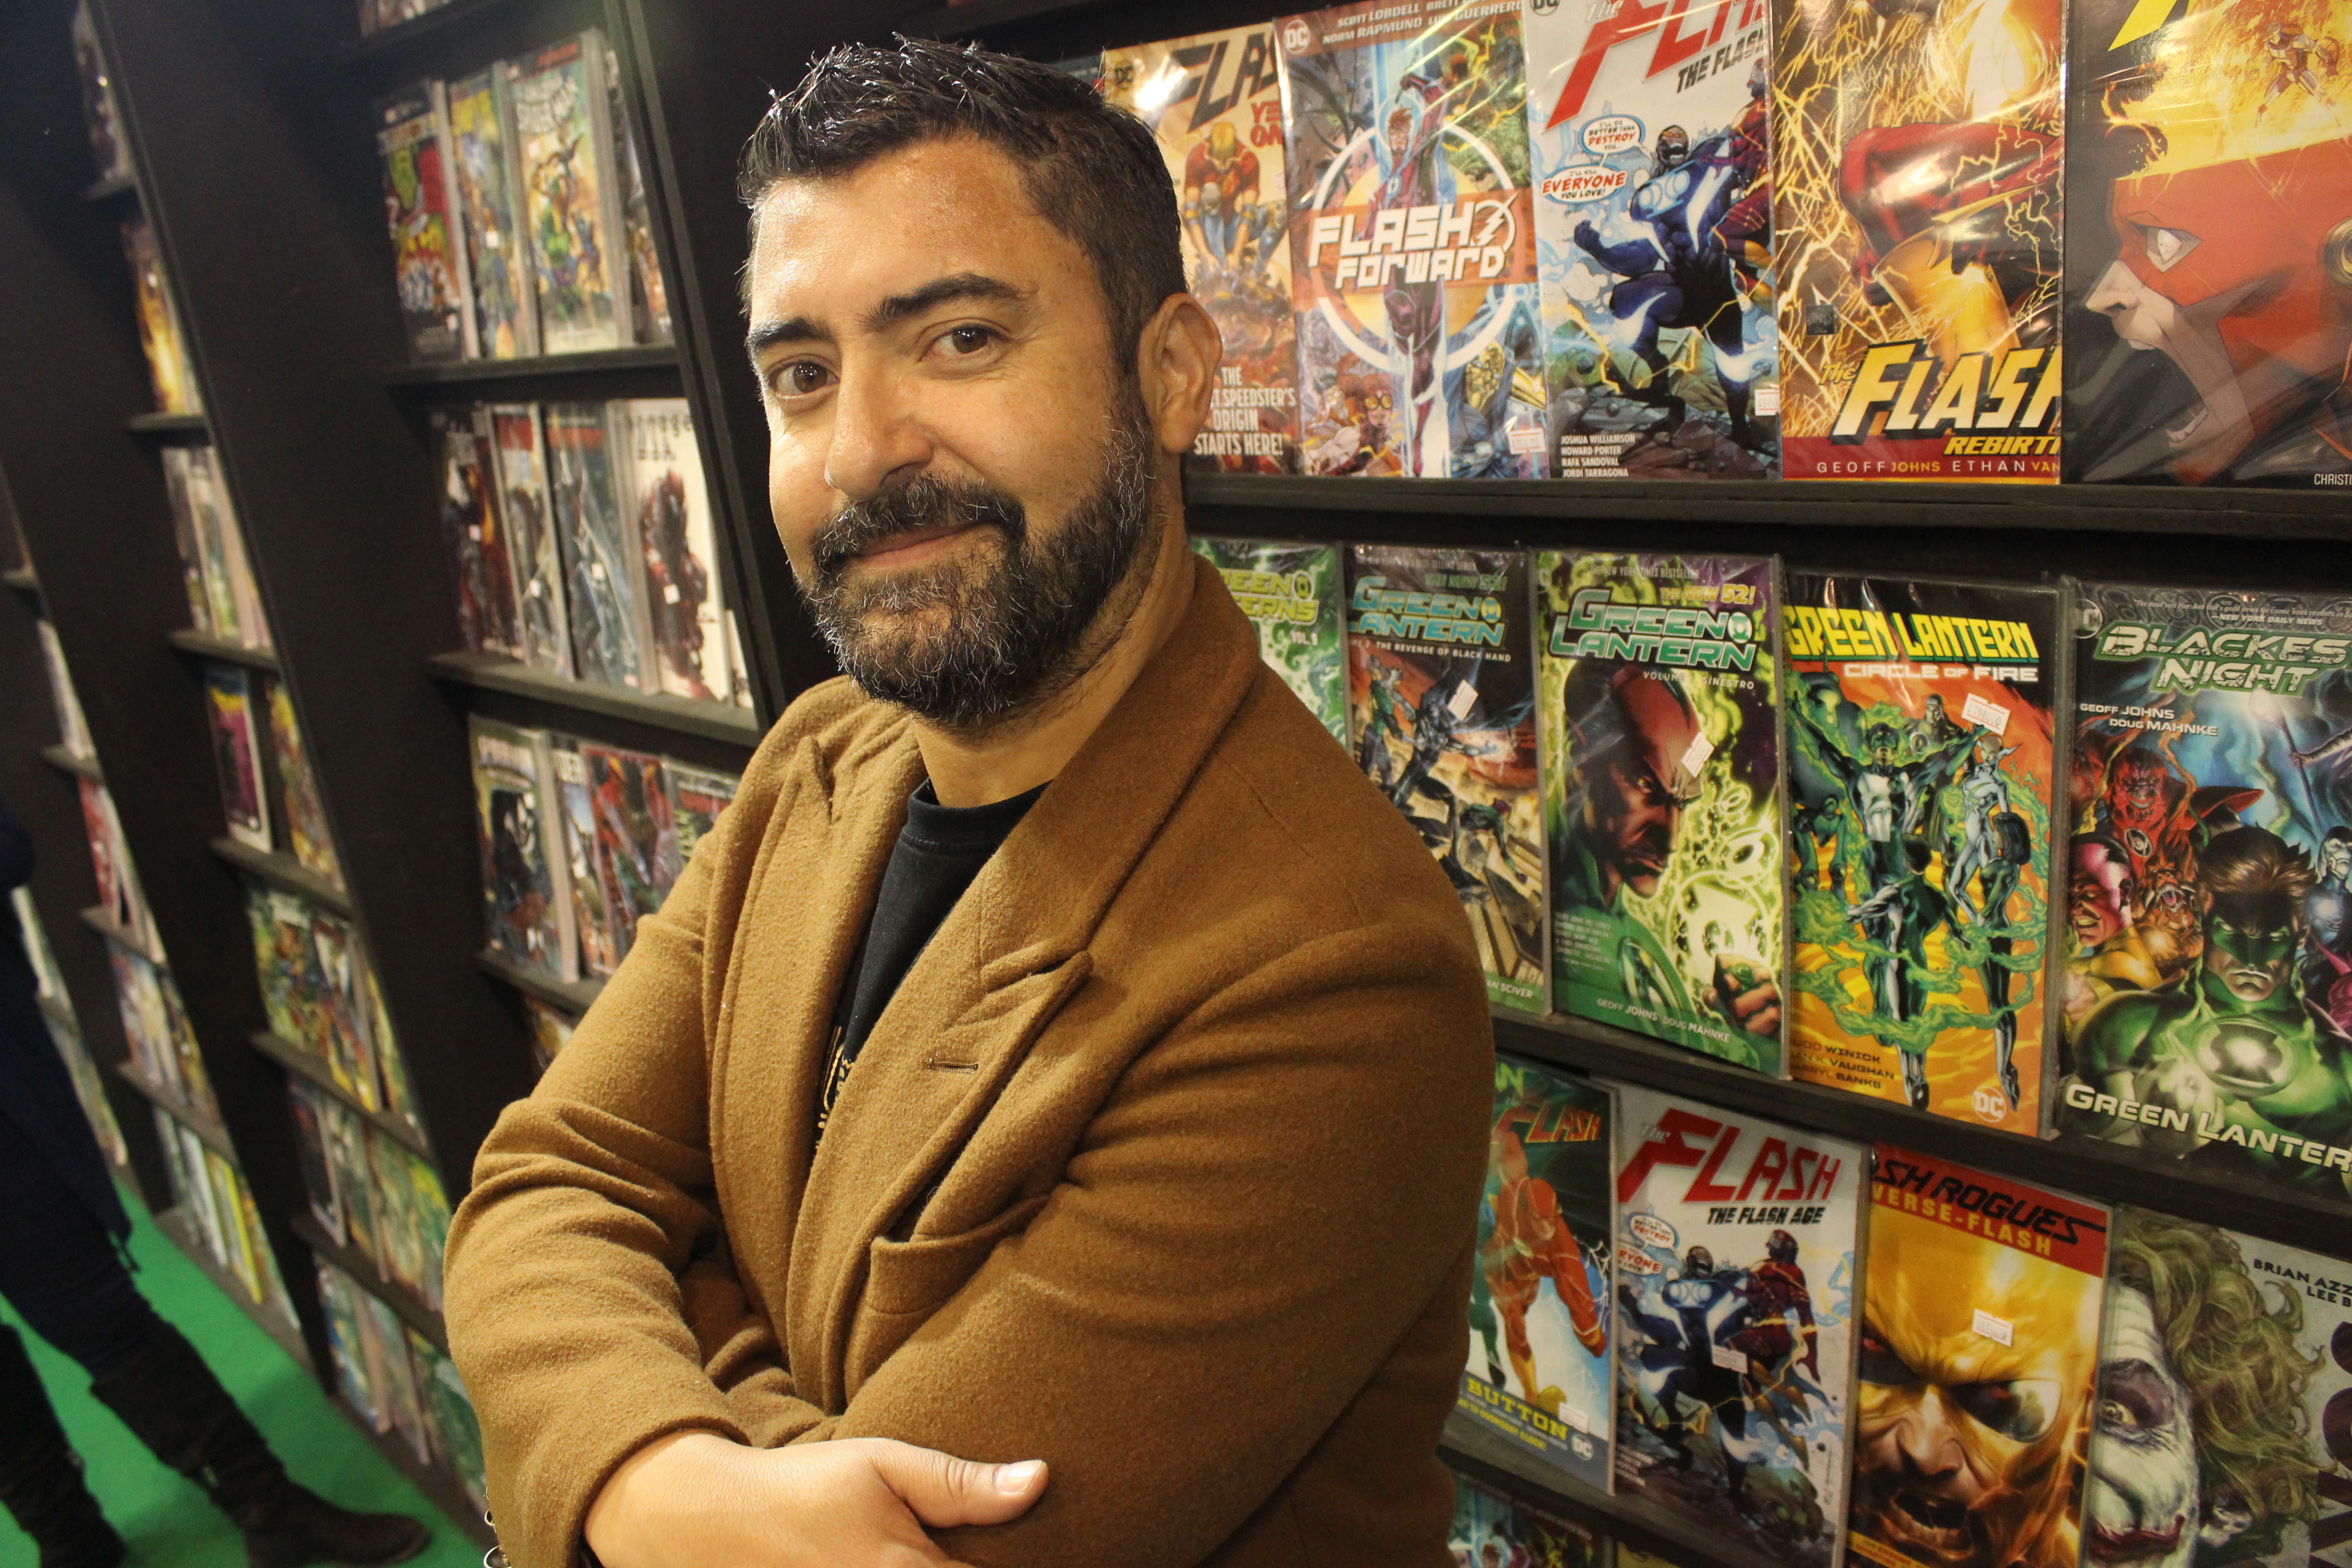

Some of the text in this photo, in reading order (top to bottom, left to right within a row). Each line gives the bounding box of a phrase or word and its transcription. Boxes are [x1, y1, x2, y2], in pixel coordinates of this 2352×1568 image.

[1338, 14, 1367, 28] SCOTT
[1369, 3, 1421, 21] LOBDELL
[1323, 30, 1355, 44] NORM
[1357, 17, 1422, 38] RAPMUND
[1677, 55, 1710, 93] THE
[1588, 132, 1636, 146] DESTROY
[1589, 126, 1617, 136] BETTER
[1542, 172, 1626, 194] EVERYONE
[1561, 188, 1606, 200] YOU LOVE!
[1308, 201, 1475, 268] FLASH
[1221, 366, 1243, 386] THE
[1819, 361, 1858, 386] The
[1222, 387, 1297, 407] SPEEDSTER'S
[1213, 408, 1259, 431] ORIGIN
[1194, 432, 1284, 456] STARTS HERE!
[1561, 433, 1636, 445] JOSHUA WILLIAMSON
[1561, 445, 1622, 455] HOWARD PORTER
[1562, 456, 1620, 467] RAFA SANDOVAL
[1563, 467, 1630, 478] JORDI TARRAGONA
[1816, 461, 1886, 473] GEOFF
[1891, 461, 1940, 472] JOHNS
[1952, 460, 2025, 472] ETHAN
[1352, 575, 1483, 620] GREEN
[1683, 585, 1720, 602] NEW
[1721, 583, 1757, 605] 52!
[1568, 589, 1730, 640] GREEN
[2241, 614, 2265, 623] YORK
[2268, 616, 2293, 625] DAILY
[2296, 617, 2323, 626] NEWS
[1551, 615, 1757, 671] LANTERN
[1782, 605, 2039, 661] GREEN LANTERN
[1376, 641, 1392, 651] THE
[1394, 643, 1434, 655] REVENGE
[1437, 647, 1450, 656] OF
[1452, 649, 1483, 659] BLACK
[1485, 652, 1511, 663] HAND
[2100, 625, 2352, 666] BLACKES
[1702, 676, 1754, 691] SINESTRO
[1843, 663, 2038, 682] CIRCLE OF FIRE
[2156, 657, 2319, 692] NIGHT
[2080, 702, 2175, 720] GEOFF JOHNS
[2109, 718, 2218, 737] DOUG MAHNKE
[1500, 982, 1534, 999] SCIVER
[1597, 998, 1731, 1043] GEOFF JOHNS DOUG MAHNKE
[1826, 1045, 1881, 1063] WINICK
[1830, 1058, 1895, 1080] VAUGHAN
[1836, 1073, 1882, 1089] BANKS
[1975, 1092, 2005, 1117] DC
[2066, 1083, 2190, 1132] GREEN
[1618, 1107, 1842, 1203] FLASH
[1707, 1207, 1826, 1225] THE FLASH AGE
[1932, 1176, 2107, 1246] ROGUES
[1634, 1225, 1671, 1242] DESTROY
[2254, 1259, 2310, 1284] BRIAN
[2306, 1286, 2337, 1303] LEE
[1467, 1377, 1568, 1441] BUTTON
